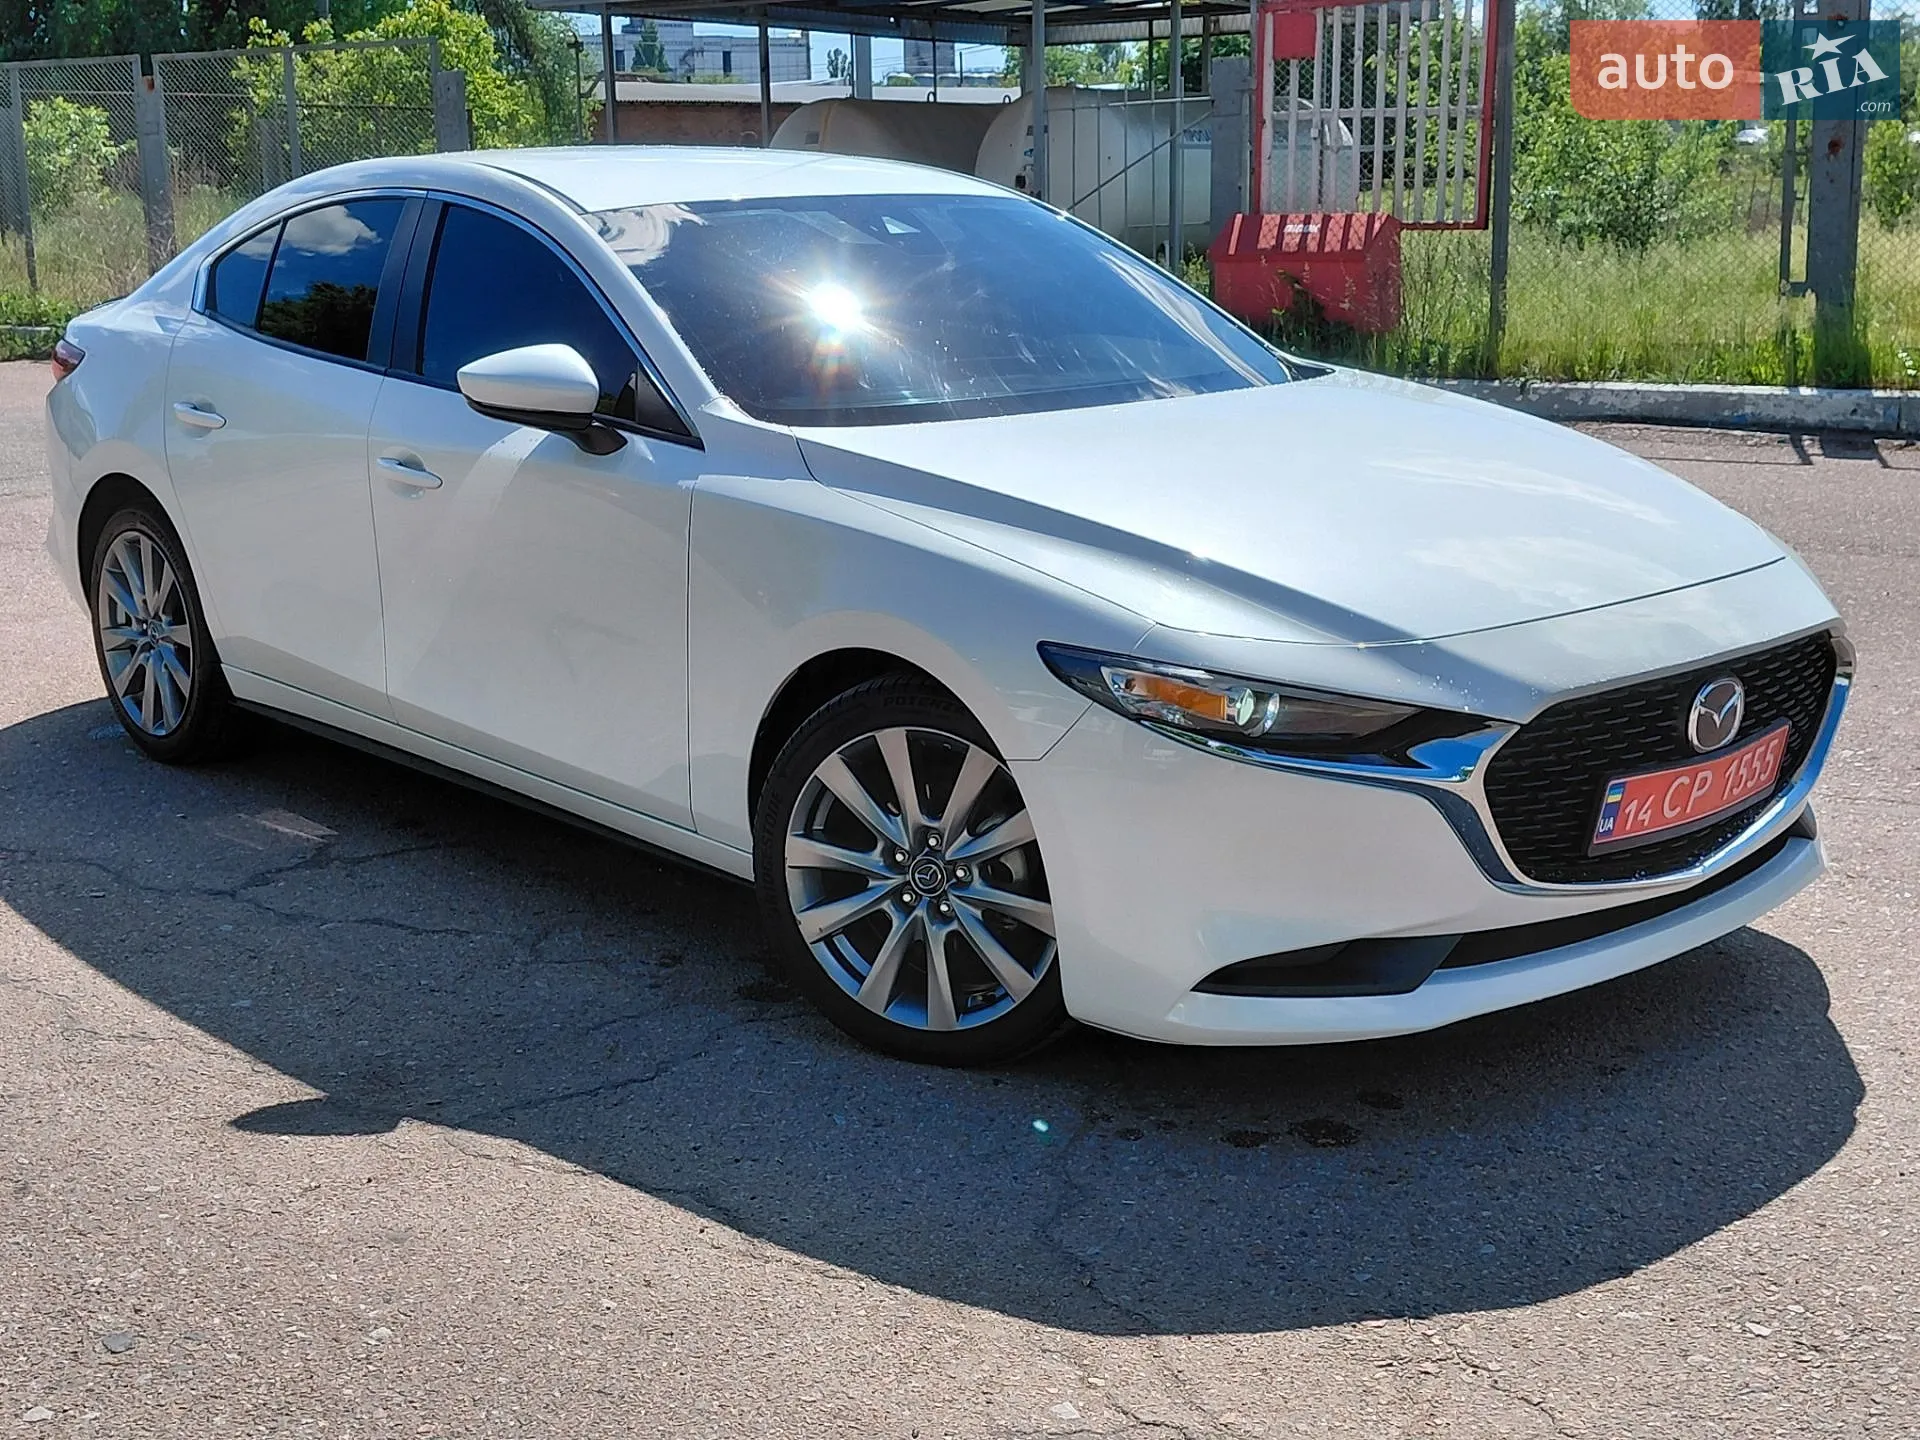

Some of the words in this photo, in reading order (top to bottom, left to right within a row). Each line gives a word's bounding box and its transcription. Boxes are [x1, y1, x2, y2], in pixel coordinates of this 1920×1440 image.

[1624, 794, 1655, 831] 14
[1662, 770, 1713, 819] CP
[1722, 738, 1779, 800] 1555
[1599, 817, 1614, 833] UA
